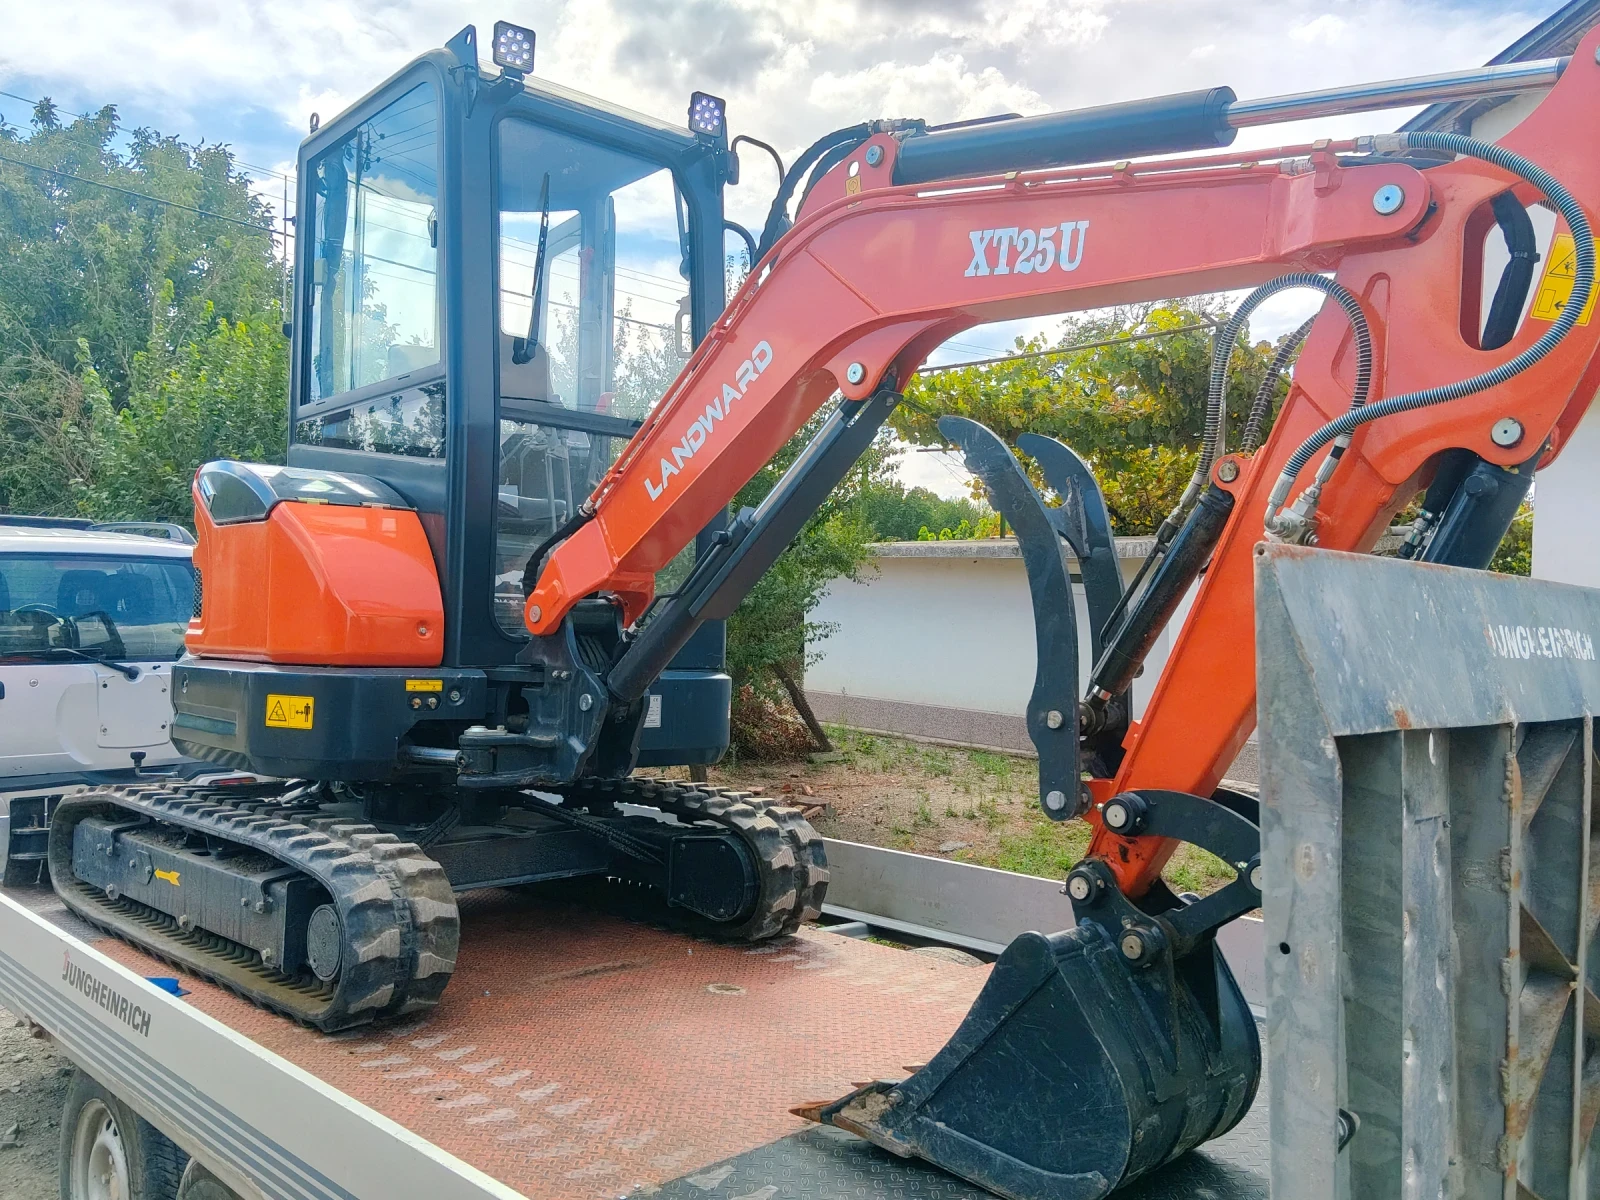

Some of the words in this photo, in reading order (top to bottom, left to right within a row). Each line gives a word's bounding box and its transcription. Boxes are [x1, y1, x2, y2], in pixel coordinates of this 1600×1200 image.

[964, 220, 1090, 277] XT25U
[644, 340, 773, 502] LANDWARD
[61, 960, 152, 1038] JUNGHEINRICH
